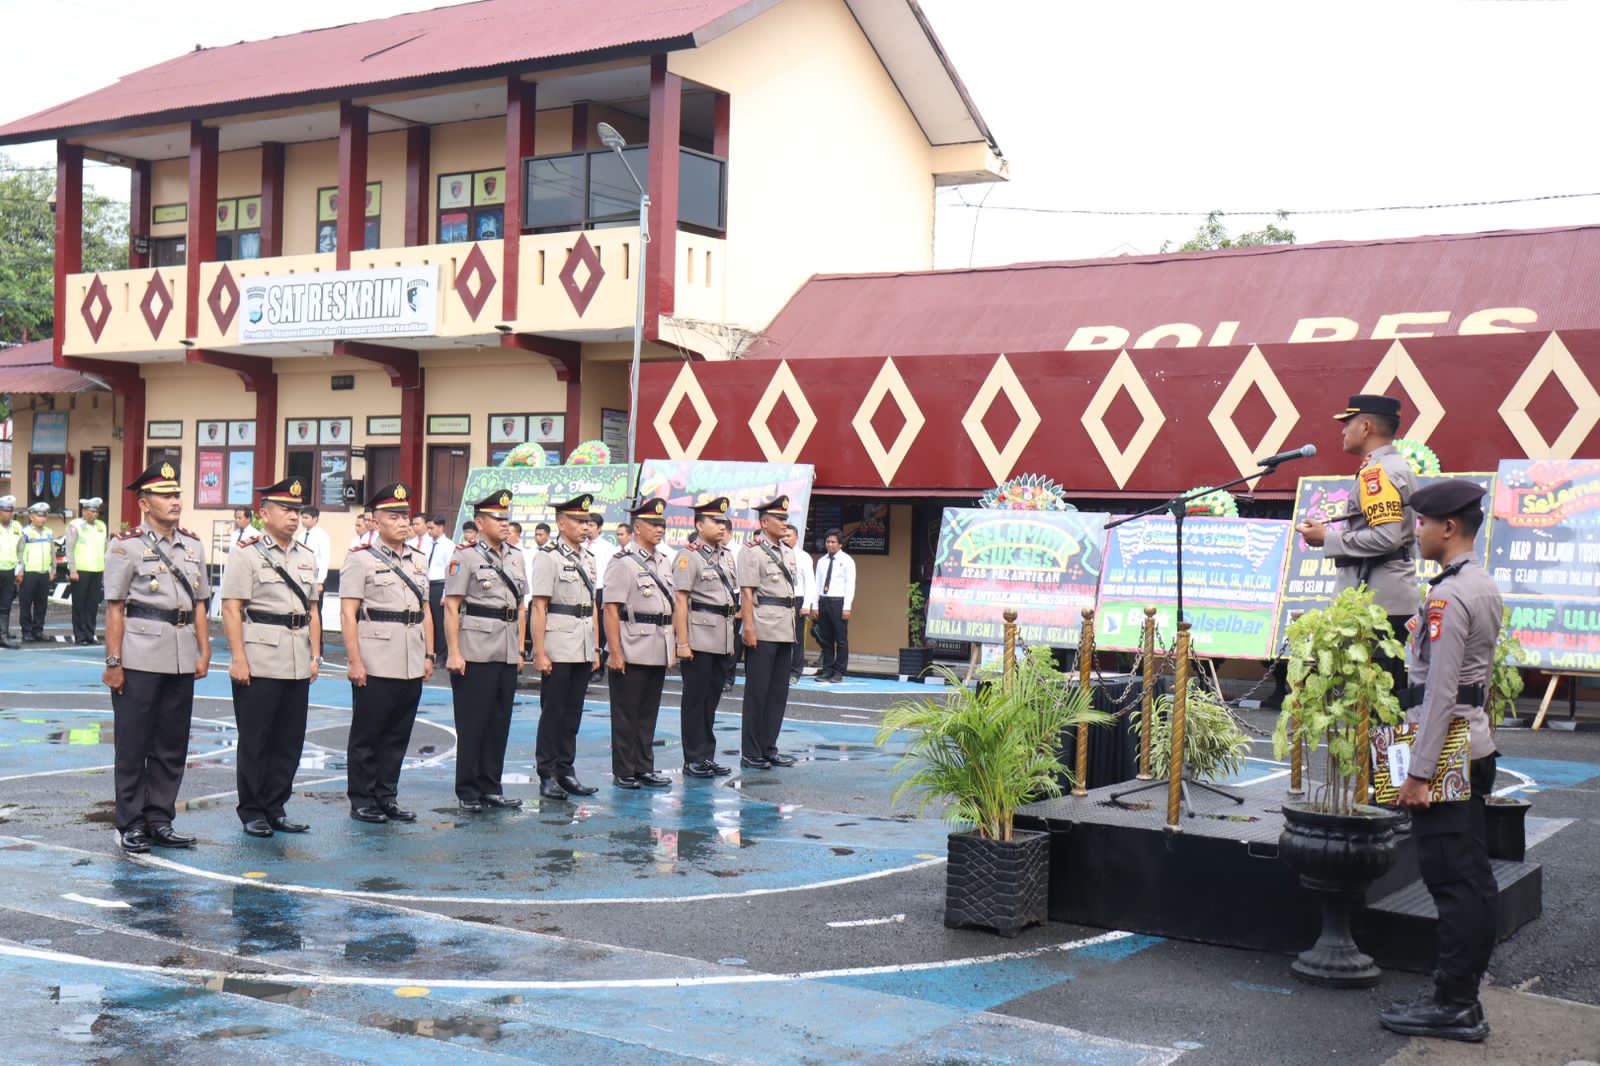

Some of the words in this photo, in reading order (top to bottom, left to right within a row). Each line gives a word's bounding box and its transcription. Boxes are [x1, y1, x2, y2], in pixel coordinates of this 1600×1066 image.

[267, 284, 306, 324] SAT
[307, 276, 403, 322] RESKRIM
[1367, 502, 1385, 517] OPS
[977, 546, 1056, 568] SUKSES
[991, 568, 1060, 582] PELANTIKAN
[1510, 606, 1556, 631] ARIF
